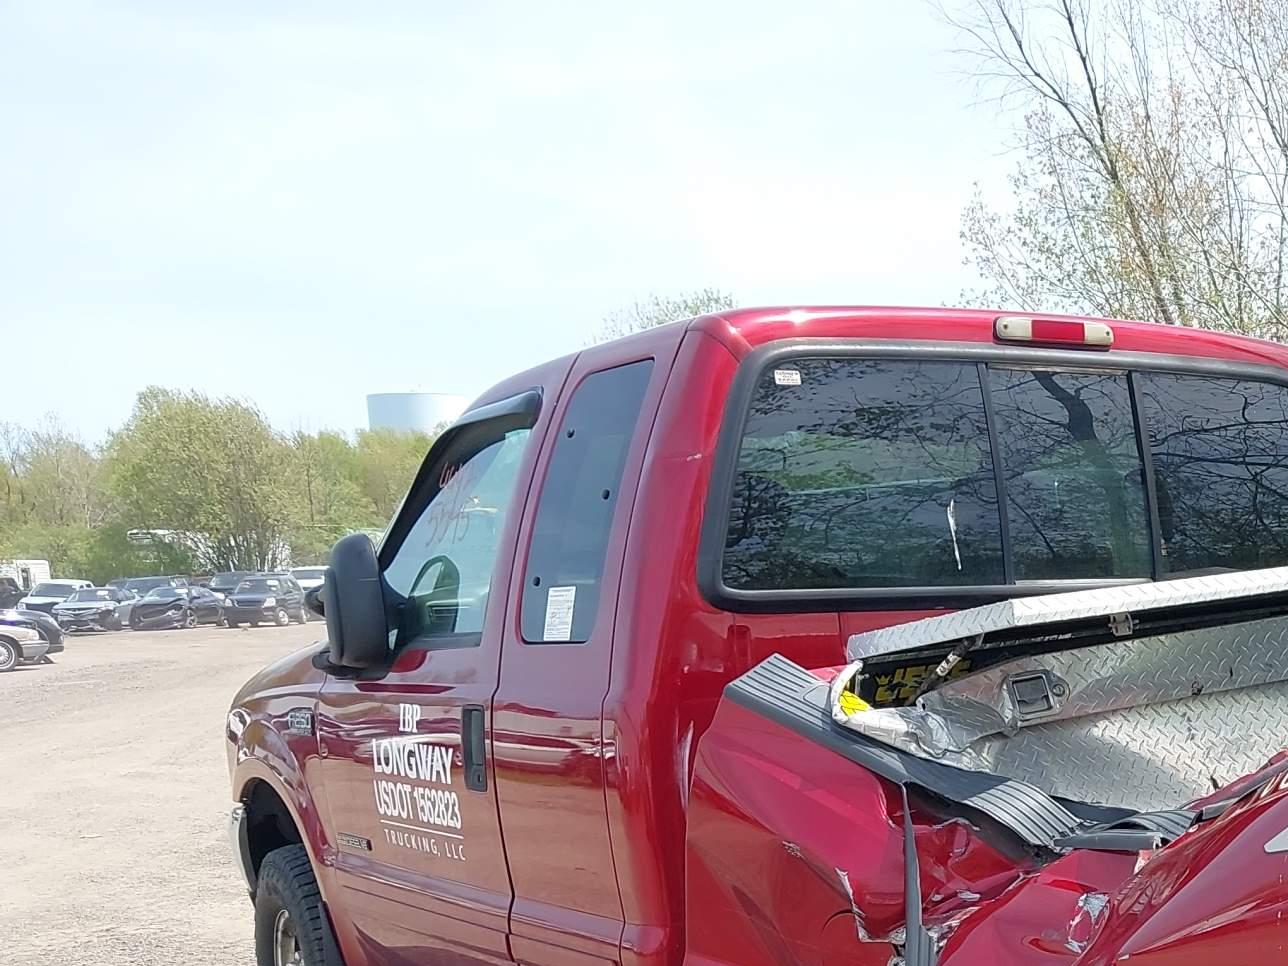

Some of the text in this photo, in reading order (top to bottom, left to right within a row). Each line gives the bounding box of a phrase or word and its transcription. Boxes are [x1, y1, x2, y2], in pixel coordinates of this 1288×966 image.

[399, 703, 421, 733] IBP
[372, 738, 454, 785] LONGWAY
[373, 779, 462, 830] USDOT 1562823
[384, 828, 441, 857] TRUCKING,
[445, 842, 466, 861] LLC
